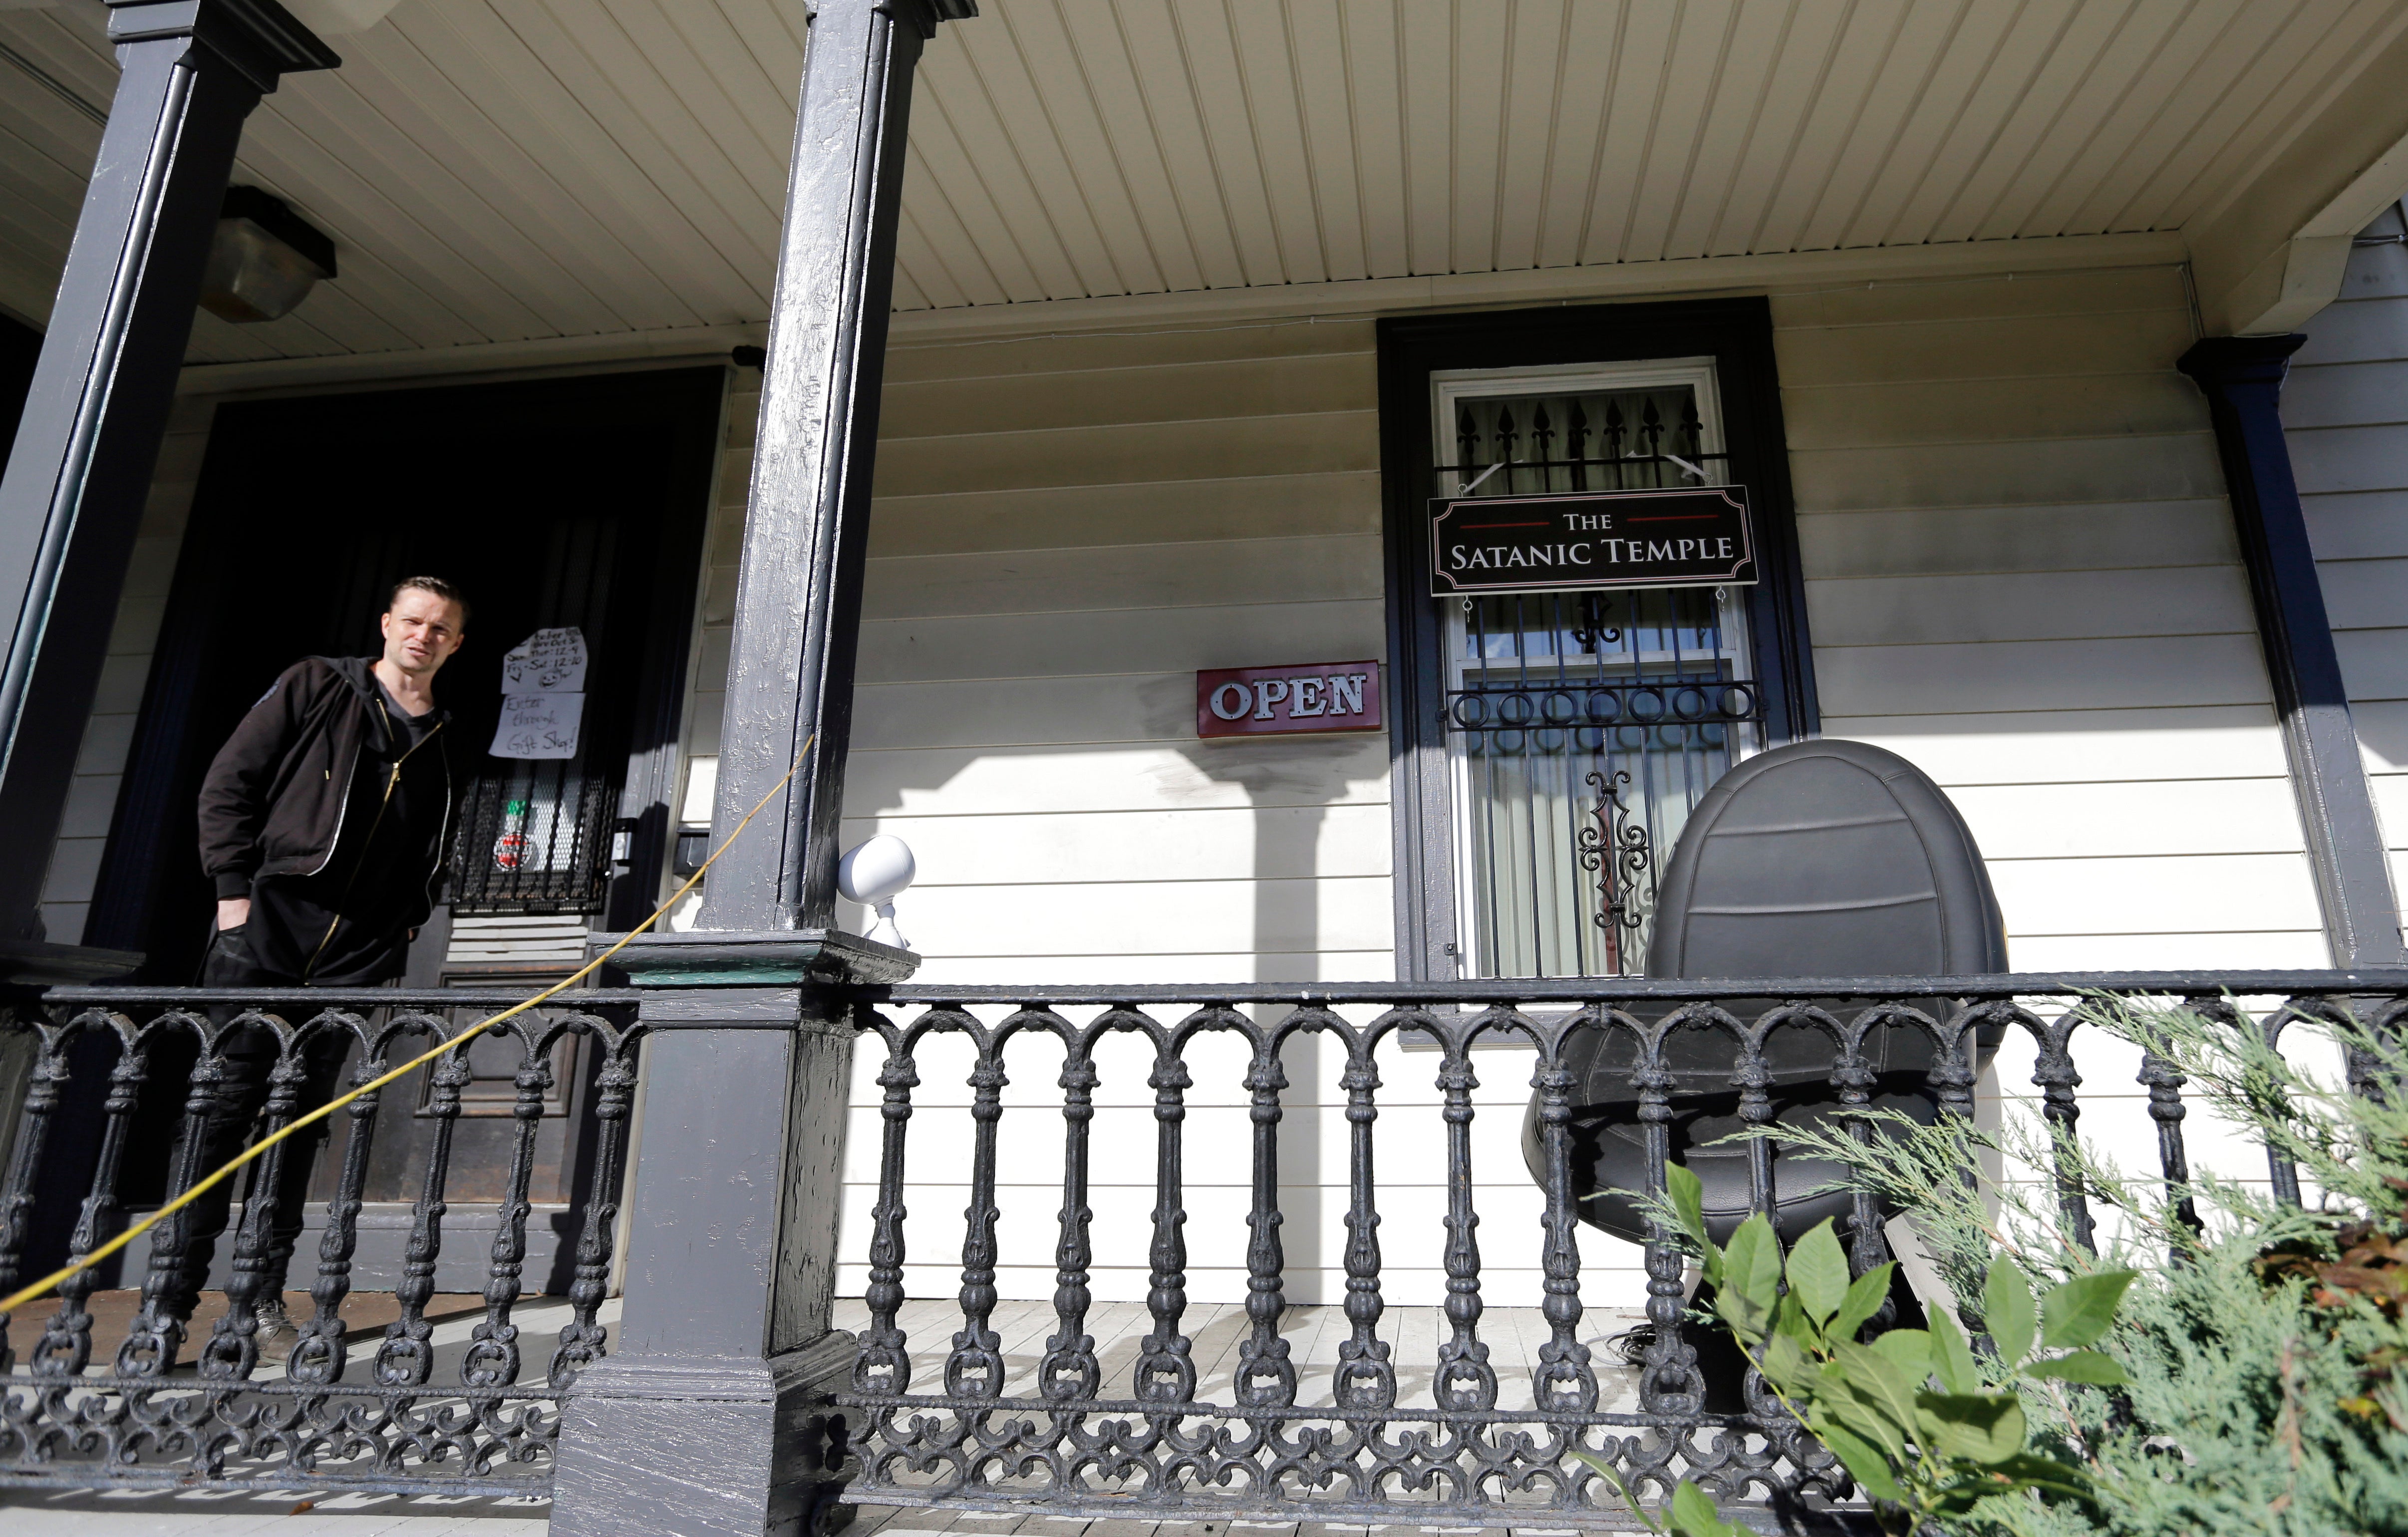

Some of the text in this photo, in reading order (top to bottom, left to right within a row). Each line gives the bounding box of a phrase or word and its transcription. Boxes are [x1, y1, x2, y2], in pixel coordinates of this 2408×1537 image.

[1563, 514, 1612, 530] THE
[1451, 537, 1733, 570] SATANIC TEMPLE
[1210, 675, 1366, 720] OPEN
[507, 732, 537, 754] Gift
